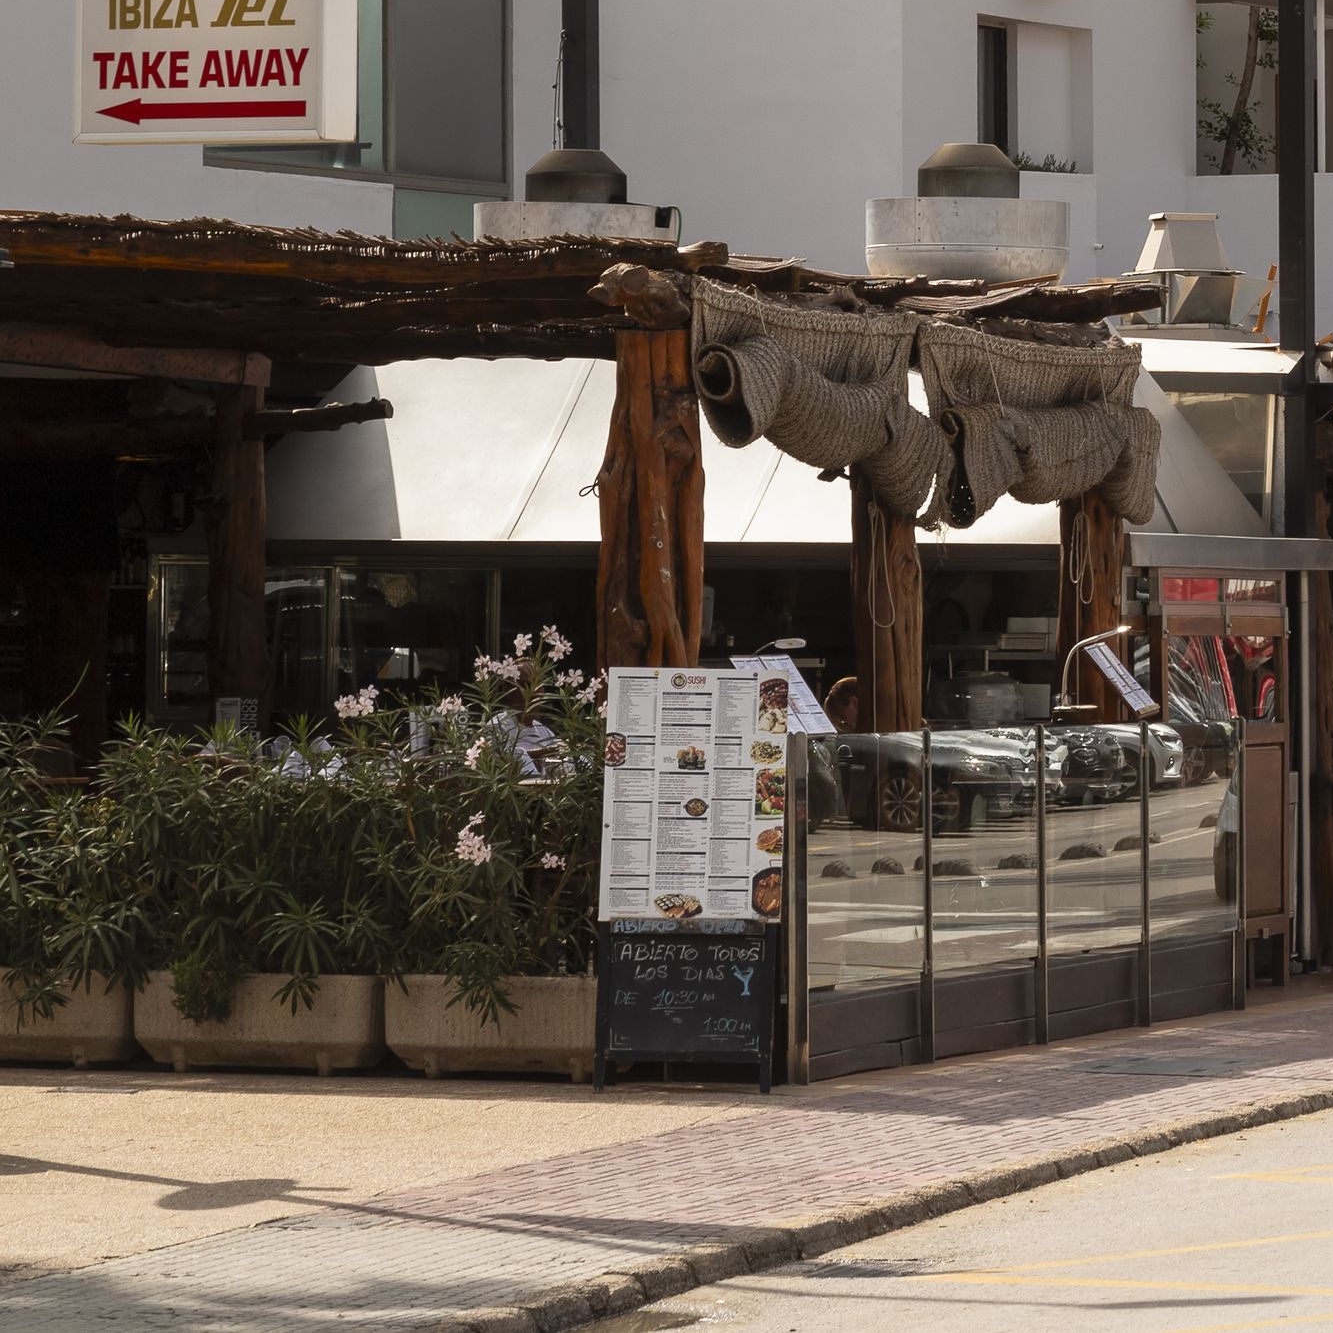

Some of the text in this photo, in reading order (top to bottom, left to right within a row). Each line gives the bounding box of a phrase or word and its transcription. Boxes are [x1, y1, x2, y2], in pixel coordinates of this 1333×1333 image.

[93, 47, 310, 90] TAKE AWAY
[619, 940, 761, 962] ABIERTO TODOS
[633, 965, 726, 983] LOS DIAS
[614, 990, 641, 1006] DE
[653, 989, 699, 1007] 10:30
[703, 1017, 738, 1033] 1:00
